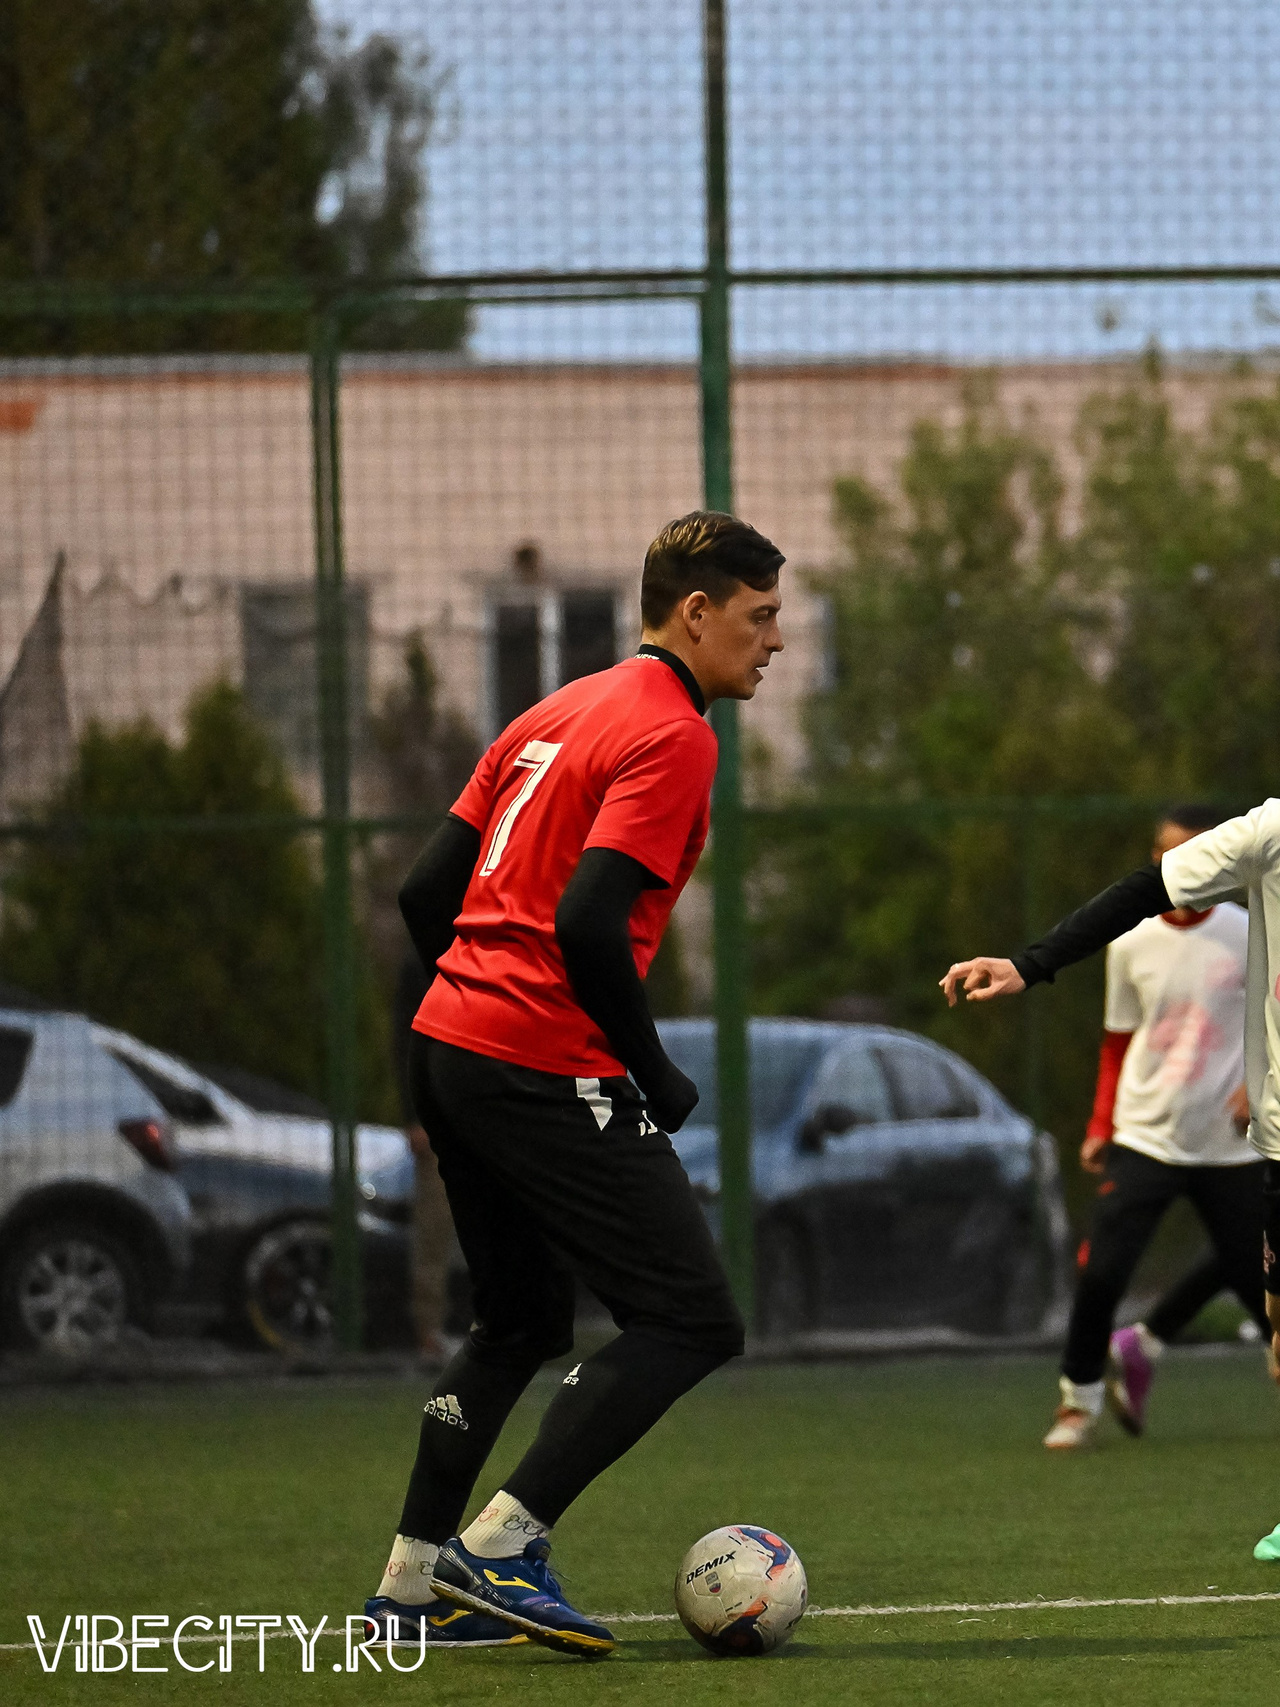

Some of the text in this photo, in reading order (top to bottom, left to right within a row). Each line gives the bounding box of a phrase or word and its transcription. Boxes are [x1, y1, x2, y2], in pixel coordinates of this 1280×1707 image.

[479, 739, 563, 877] 7
[424, 1397, 469, 1431] adidas
[686, 1550, 736, 1584] DEMIX
